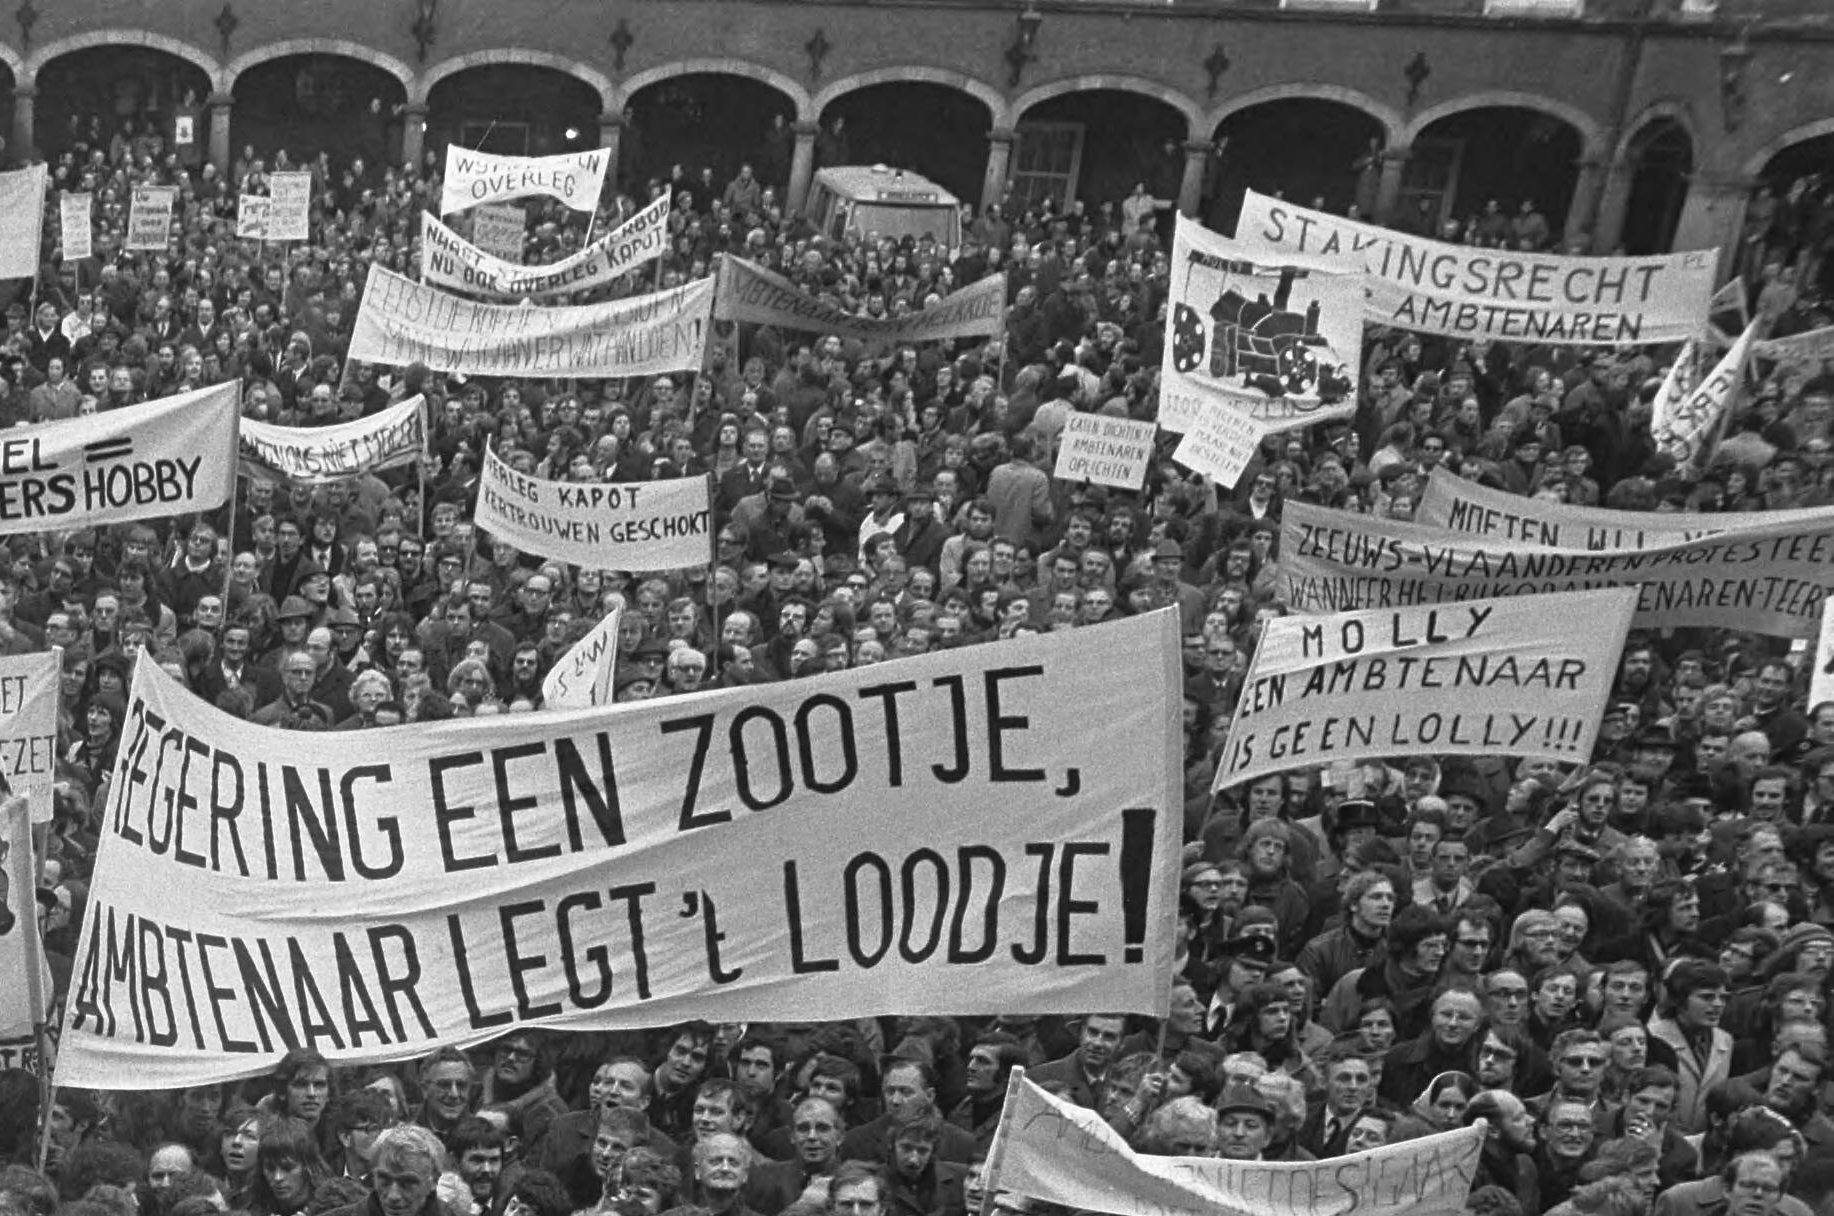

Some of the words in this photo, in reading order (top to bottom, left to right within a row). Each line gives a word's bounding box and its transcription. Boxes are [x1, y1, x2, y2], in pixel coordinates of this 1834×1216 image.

[472, 169, 576, 199] OVERLEG
[431, 252, 454, 275] NU
[464, 266, 497, 291] OOK
[510, 262, 598, 294] OVERLEG
[1391, 299, 1645, 341] AMBTENAREN
[483, 484, 601, 545] VERTROUWEN
[609, 509, 710, 545] GESCHOKT
[557, 486, 641, 512] KAPOT
[1302, 606, 1493, 658] MOLLY
[1303, 654, 1587, 699] AMBTENAAR
[1230, 738, 1254, 774] IS
[1269, 715, 1372, 760] GEEN
[1391, 711, 1584, 751] LOLLY!!!
[113, 697, 406, 883] REGERING
[428, 731, 624, 874] EEN
[662, 666, 1083, 832] ZOOTJE,
[72, 900, 440, 1056] AMBTENAAR
[446, 879, 656, 1031] LEGT
[783, 808, 1157, 973] LOODJE!
